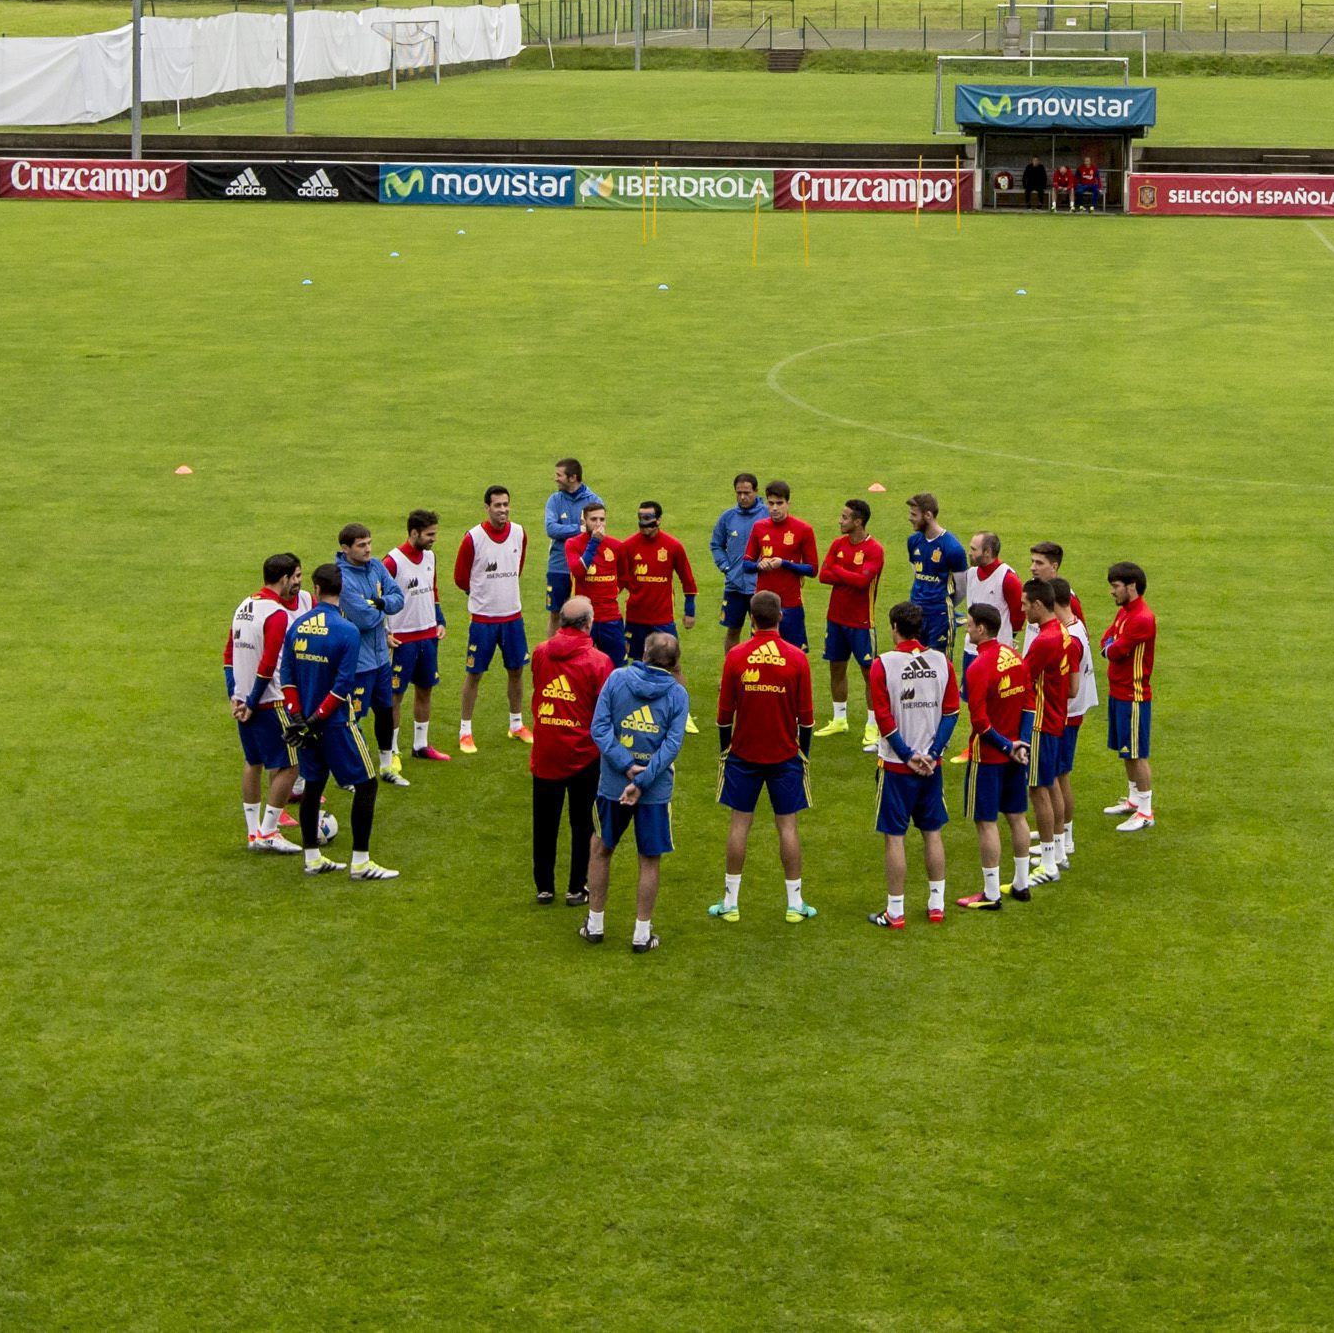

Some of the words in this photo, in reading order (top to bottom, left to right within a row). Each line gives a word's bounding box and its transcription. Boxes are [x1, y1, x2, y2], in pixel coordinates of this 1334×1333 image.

[1017, 95, 1133, 118] movistar
[10, 159, 167, 199] Cruzcampo
[431, 171, 572, 198] movistar
[225, 184, 267, 197] adidas
[297, 185, 339, 198] adidas
[617, 175, 770, 199] IBERDROLA
[789, 170, 953, 209] Cruzcampo
[1168, 186, 1252, 205] SELECCIÓN
[297, 624, 329, 636] adidas
[748, 654, 786, 666] adidas
[902, 669, 938, 680] adidas
[542, 688, 576, 702] adidas
[745, 684, 786, 694] IBERDROLA
[540, 717, 582, 728] IBERDROLA
[621, 719, 660, 734] adidas
